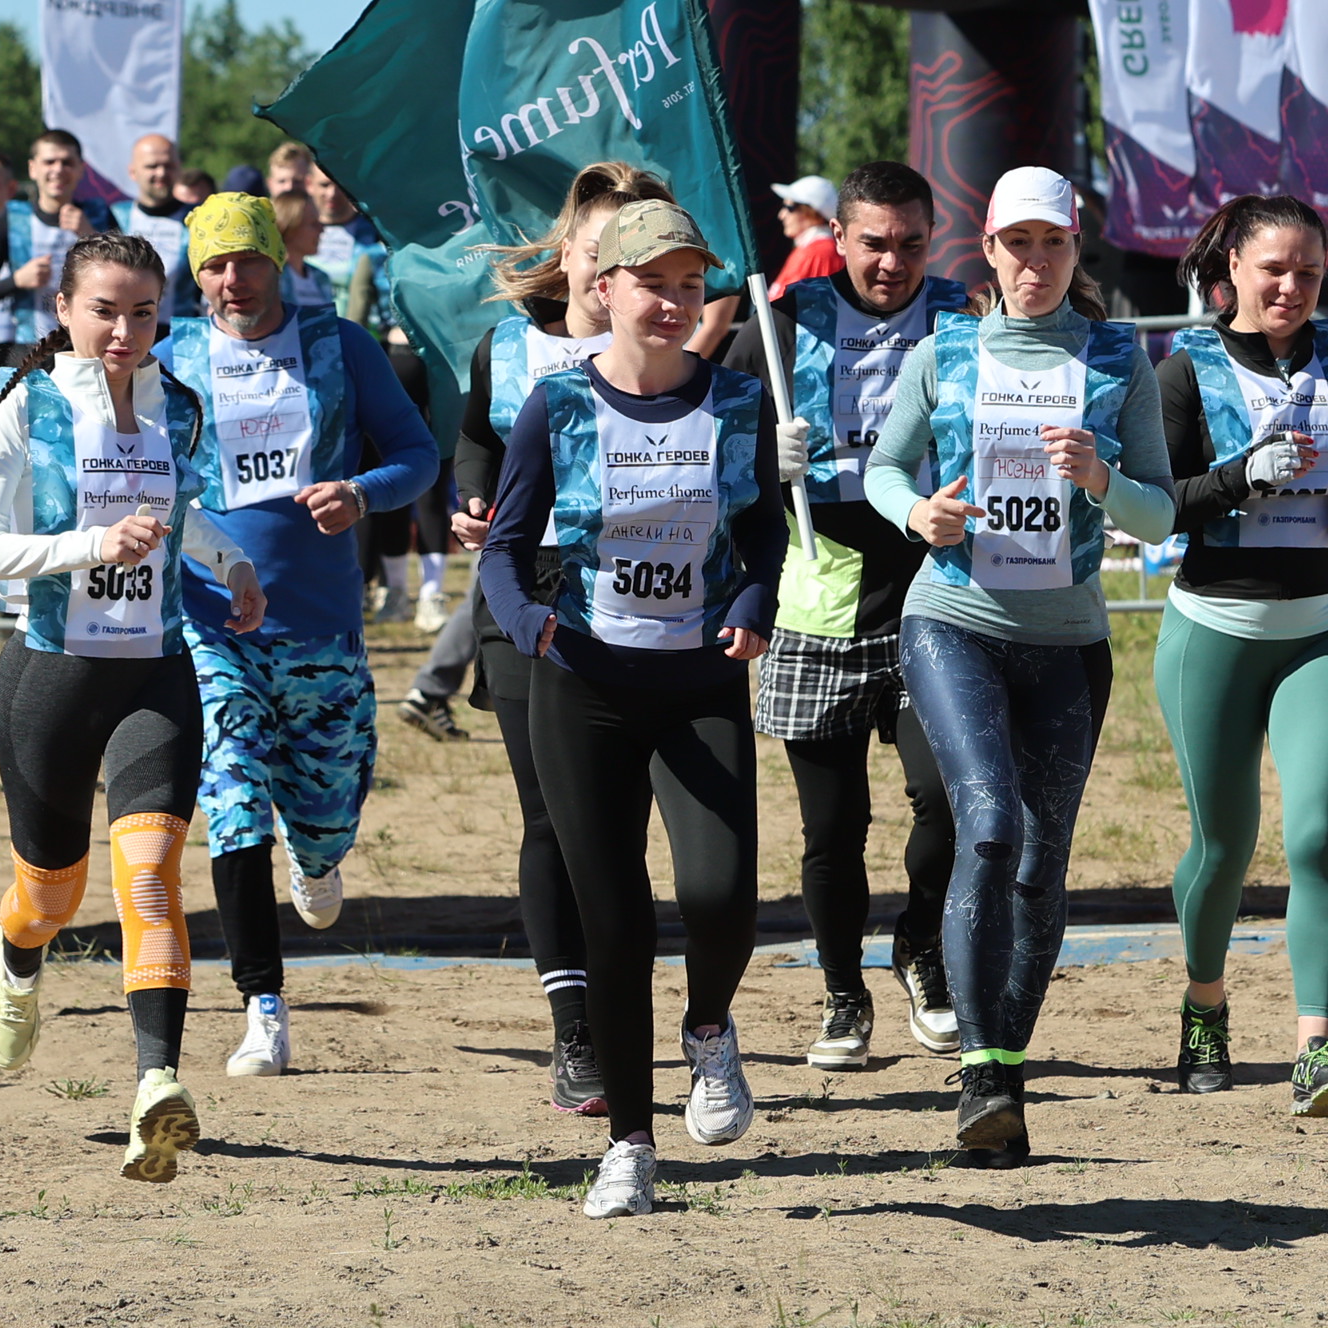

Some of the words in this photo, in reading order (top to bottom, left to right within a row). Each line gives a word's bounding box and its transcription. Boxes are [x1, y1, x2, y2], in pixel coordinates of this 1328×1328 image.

[840, 337, 876, 349] ГОНКА
[216, 362, 254, 376] ГОНКА
[256, 356, 297, 372] ГЕРОЕВ
[533, 359, 569, 377] ГОНКА
[981, 392, 1024, 404] ГОНКА
[1027, 394, 1077, 406] ГЕРОЕВ
[82, 458, 124, 469] ГОНКА
[126, 459, 170, 471] ГЕРОЕВ
[606, 451, 653, 464] ГОНКА
[657, 450, 710, 463] ГЕРОЕВ
[236, 447, 300, 485] 5037
[987, 495, 1062, 532] 5028
[1272, 515, 1317, 524] ГАЗПРОМБАНК
[1005, 556, 1057, 566] ГАЗПРОМБАНК
[87, 564, 153, 601] 5033
[612, 558, 692, 600] 5034
